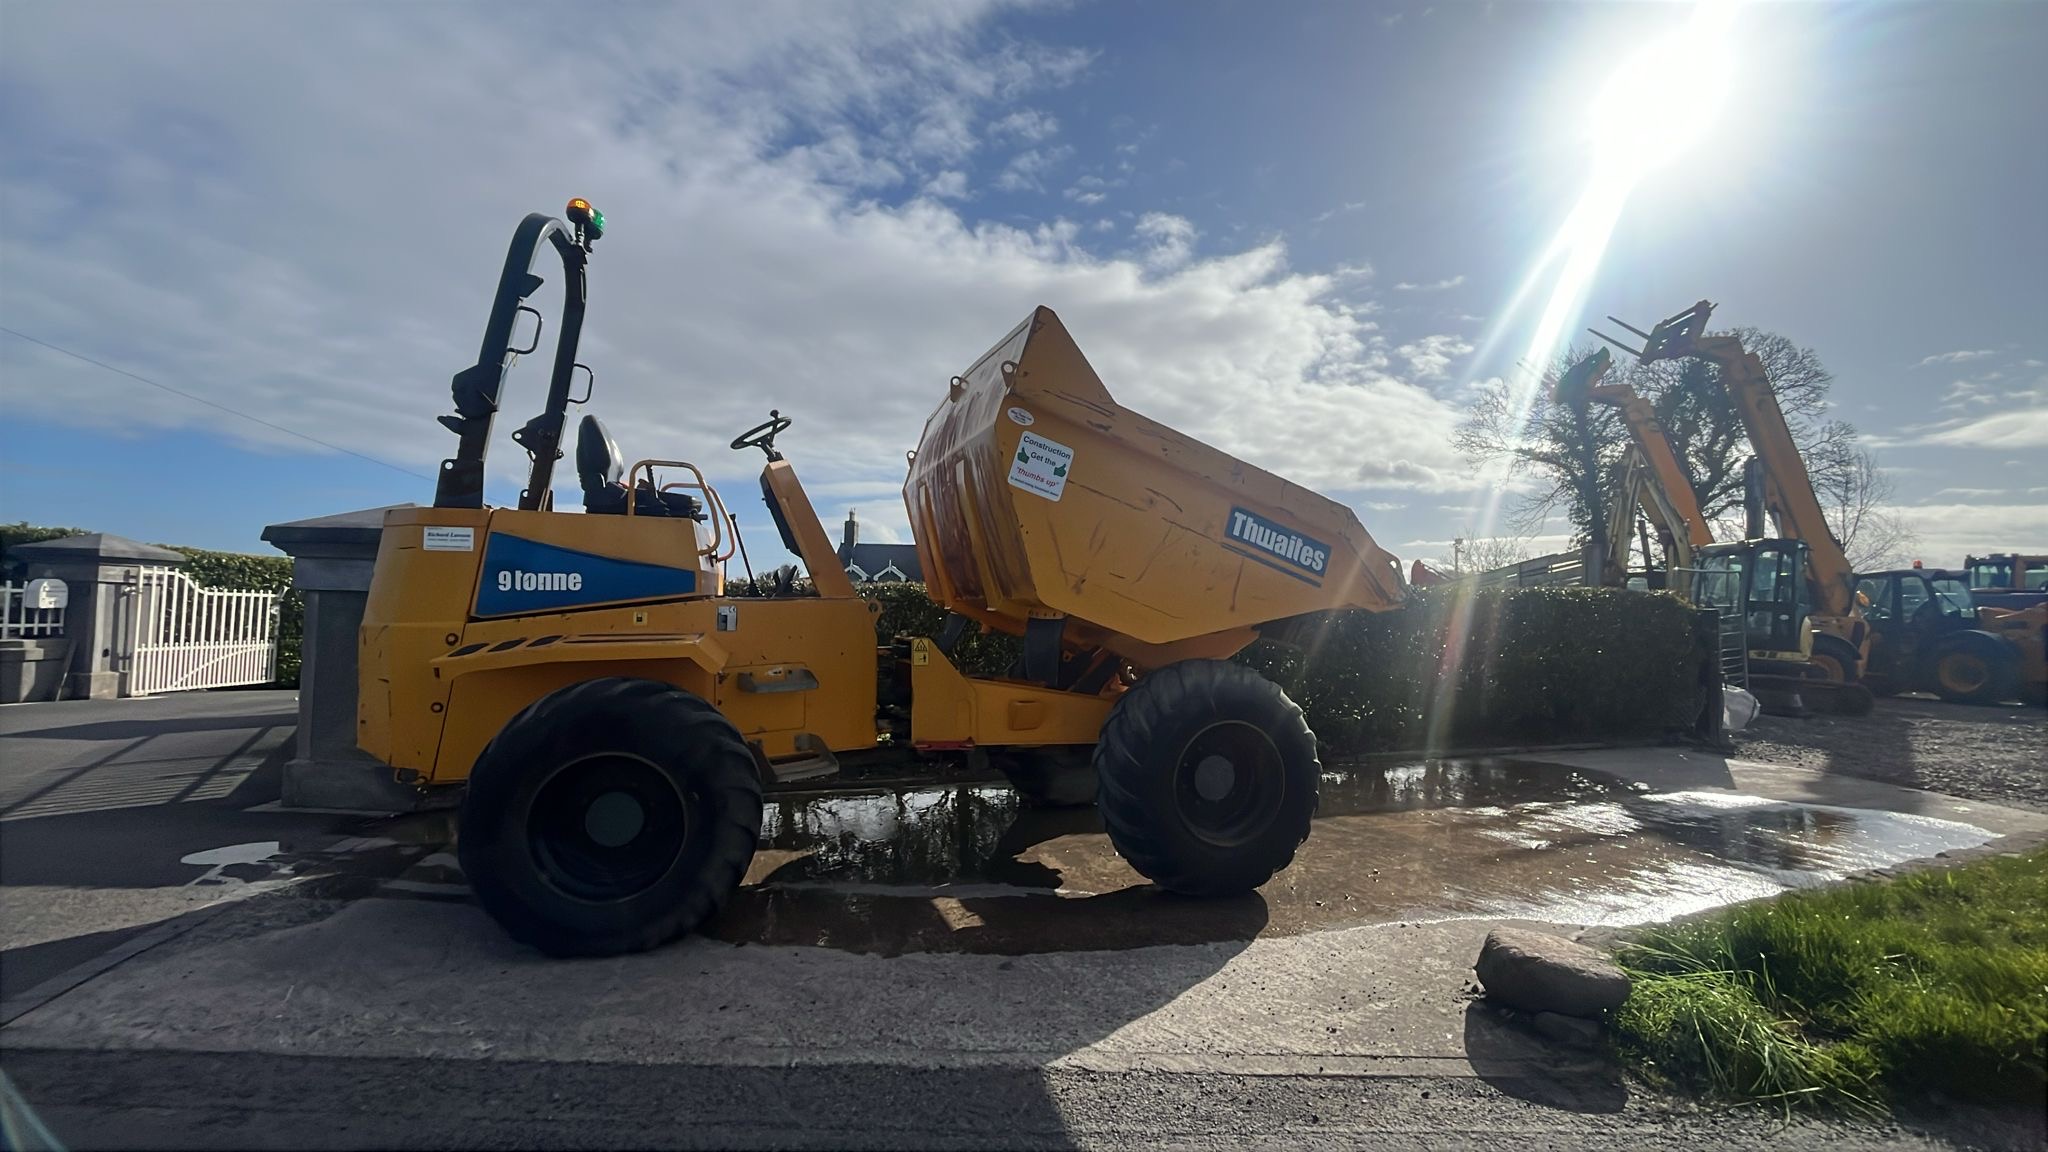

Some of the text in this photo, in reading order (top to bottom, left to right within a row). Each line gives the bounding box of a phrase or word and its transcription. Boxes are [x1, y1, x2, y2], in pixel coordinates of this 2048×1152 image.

[1023, 435, 1071, 460] Construction
[1030, 451, 1056, 467] Get the
[1232, 511, 1325, 571] Thwaites
[498, 570, 582, 591] 9 tonne
